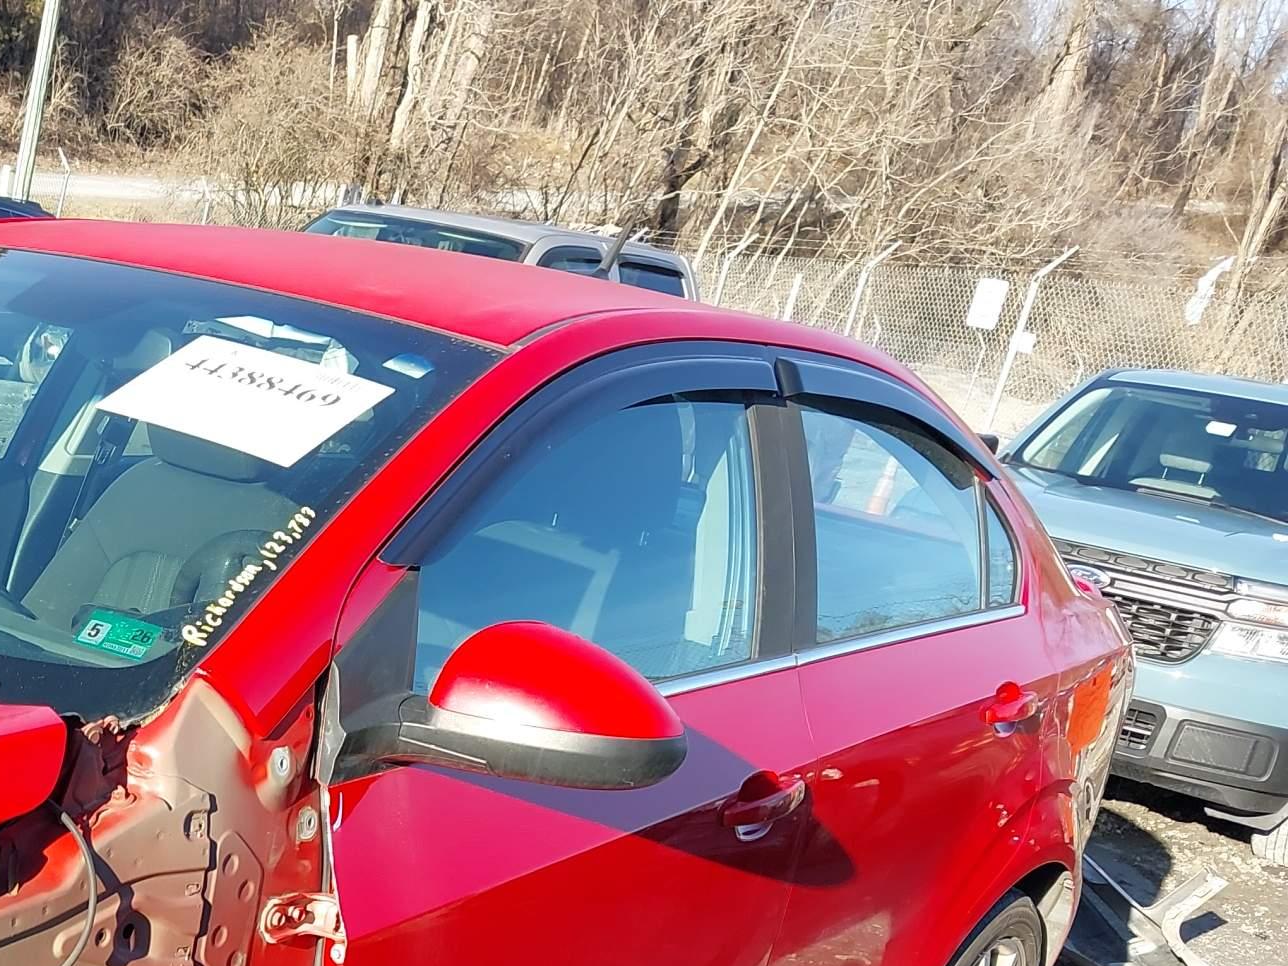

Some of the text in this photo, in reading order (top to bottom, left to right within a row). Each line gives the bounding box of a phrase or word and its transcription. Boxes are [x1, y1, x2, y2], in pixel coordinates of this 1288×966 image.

[185, 358, 341, 407] 44388469
[87, 622, 104, 638] 5
[131, 629, 154, 644] 26
